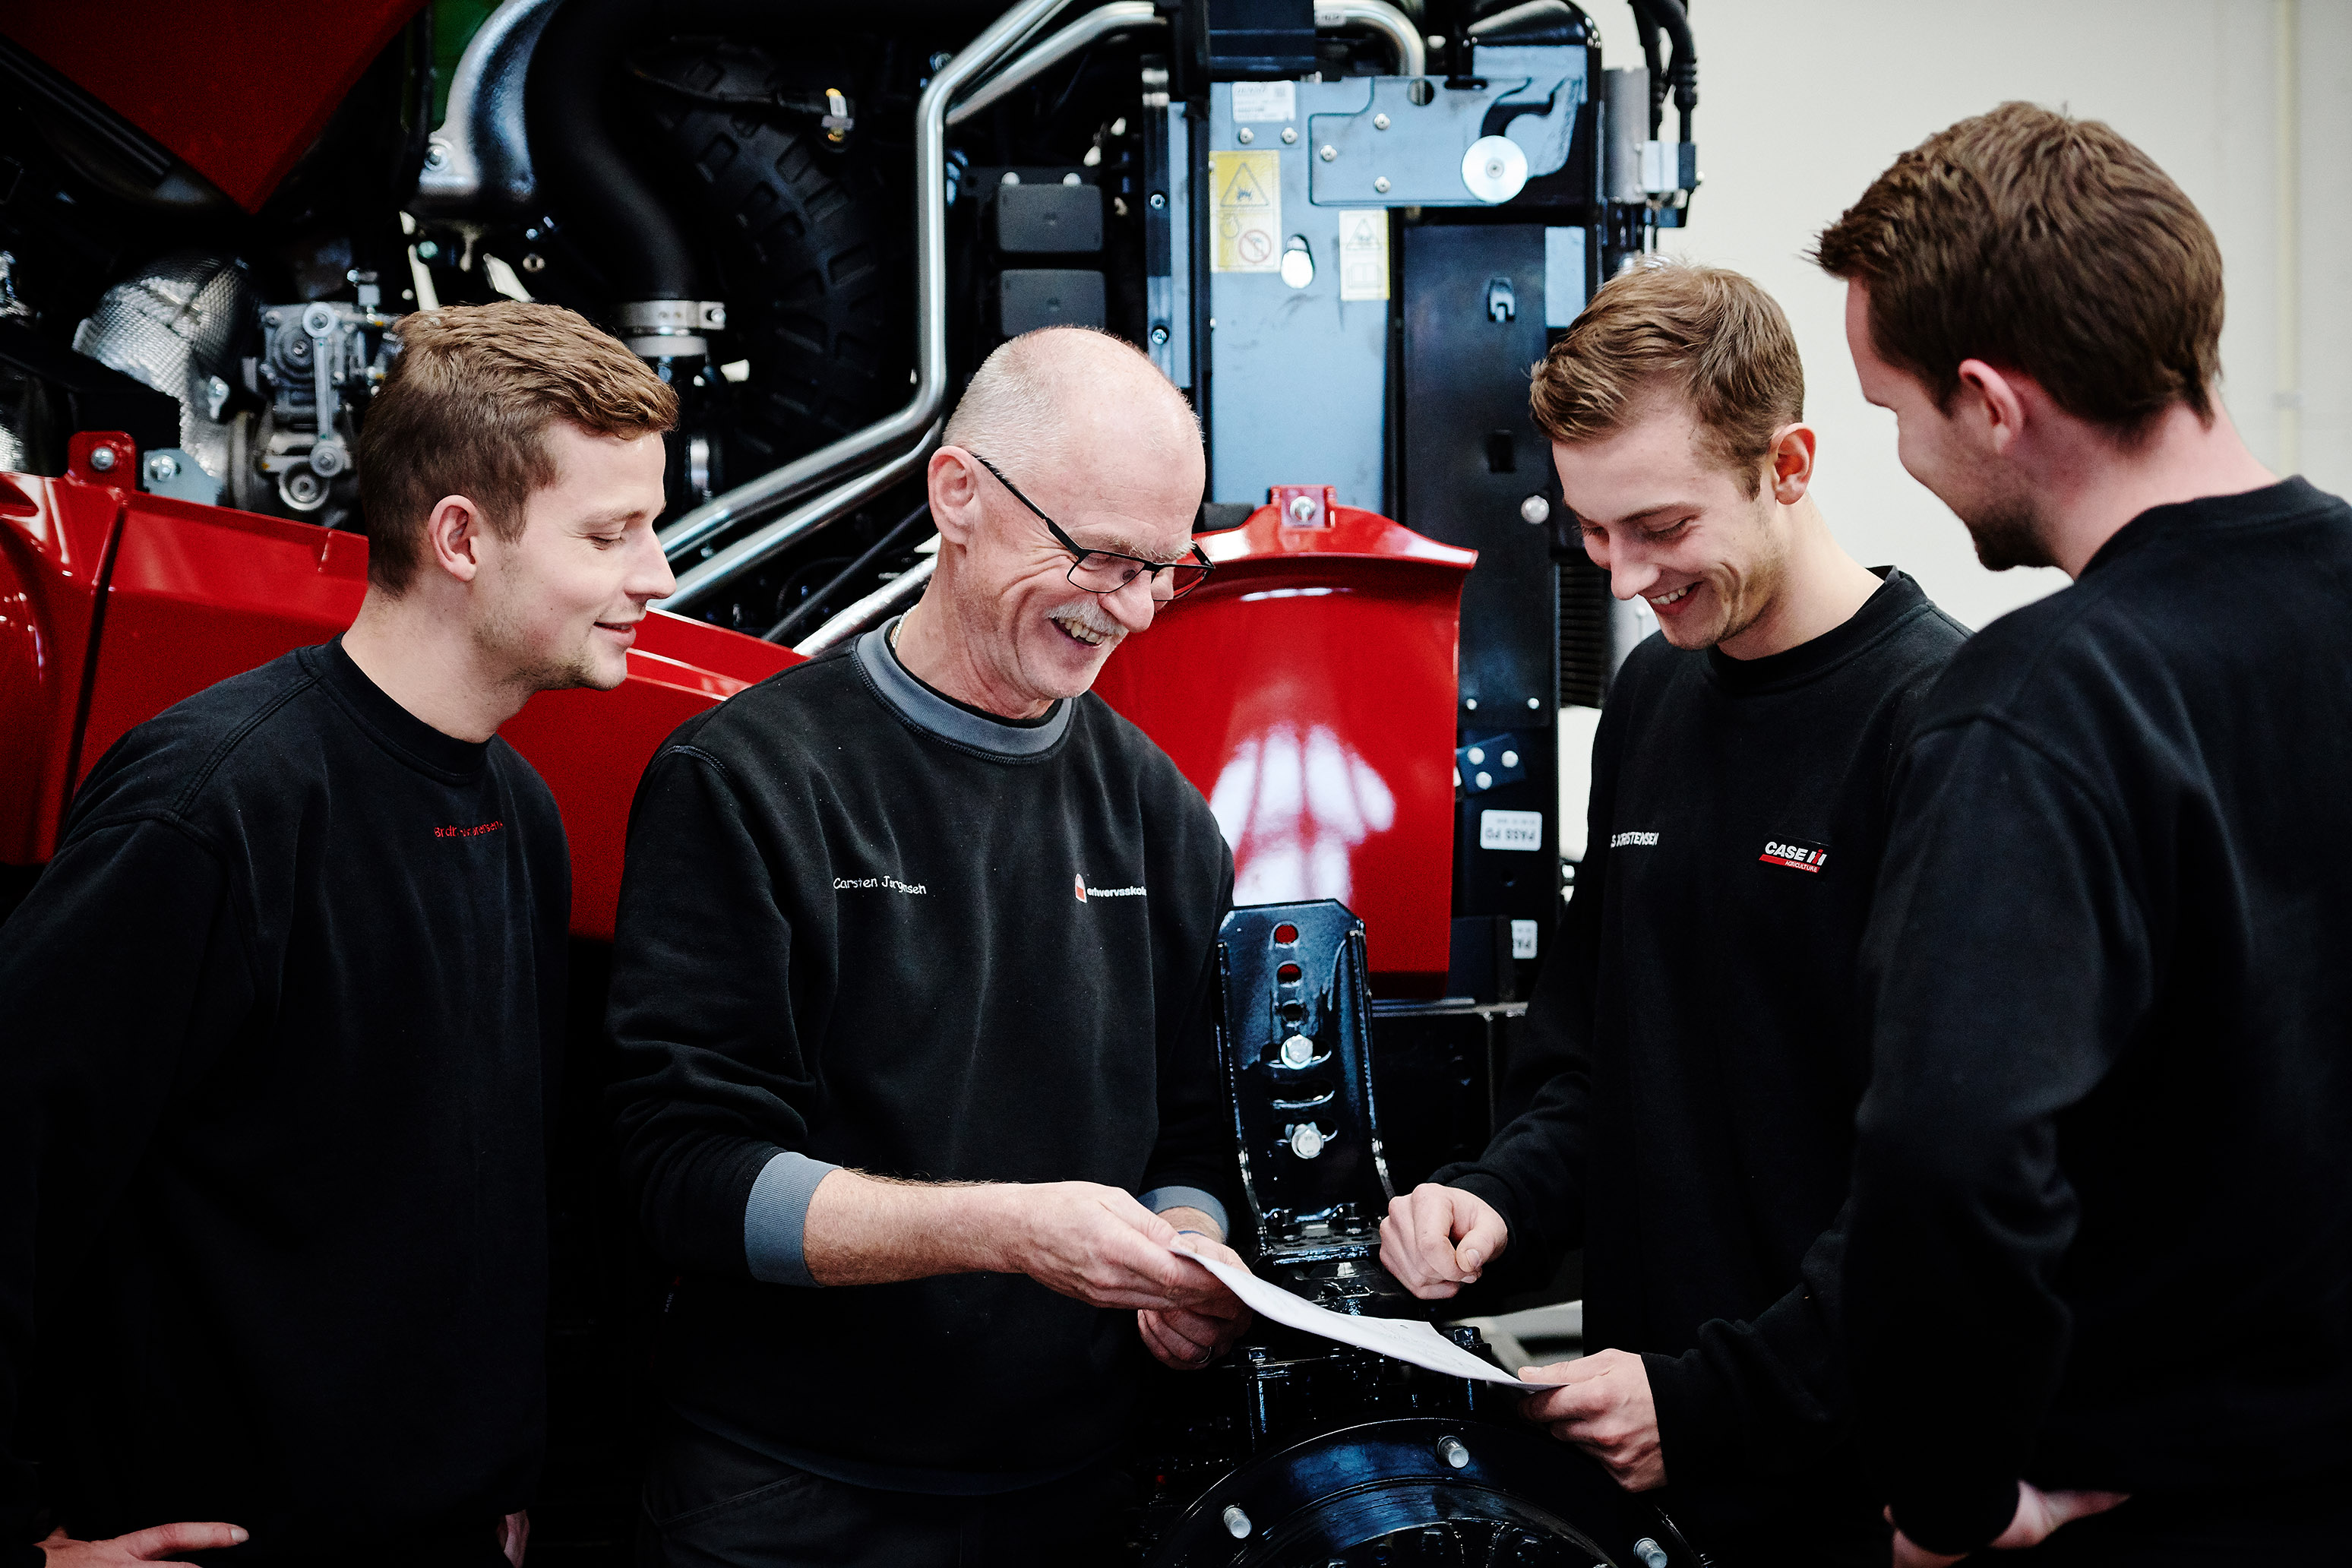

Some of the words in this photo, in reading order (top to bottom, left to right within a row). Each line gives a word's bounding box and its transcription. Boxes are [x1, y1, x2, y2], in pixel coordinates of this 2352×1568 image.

[1765, 841, 1808, 861] CASE
[1785, 860, 1818, 873] AGRICULTURE
[832, 877, 878, 890] Carsten
